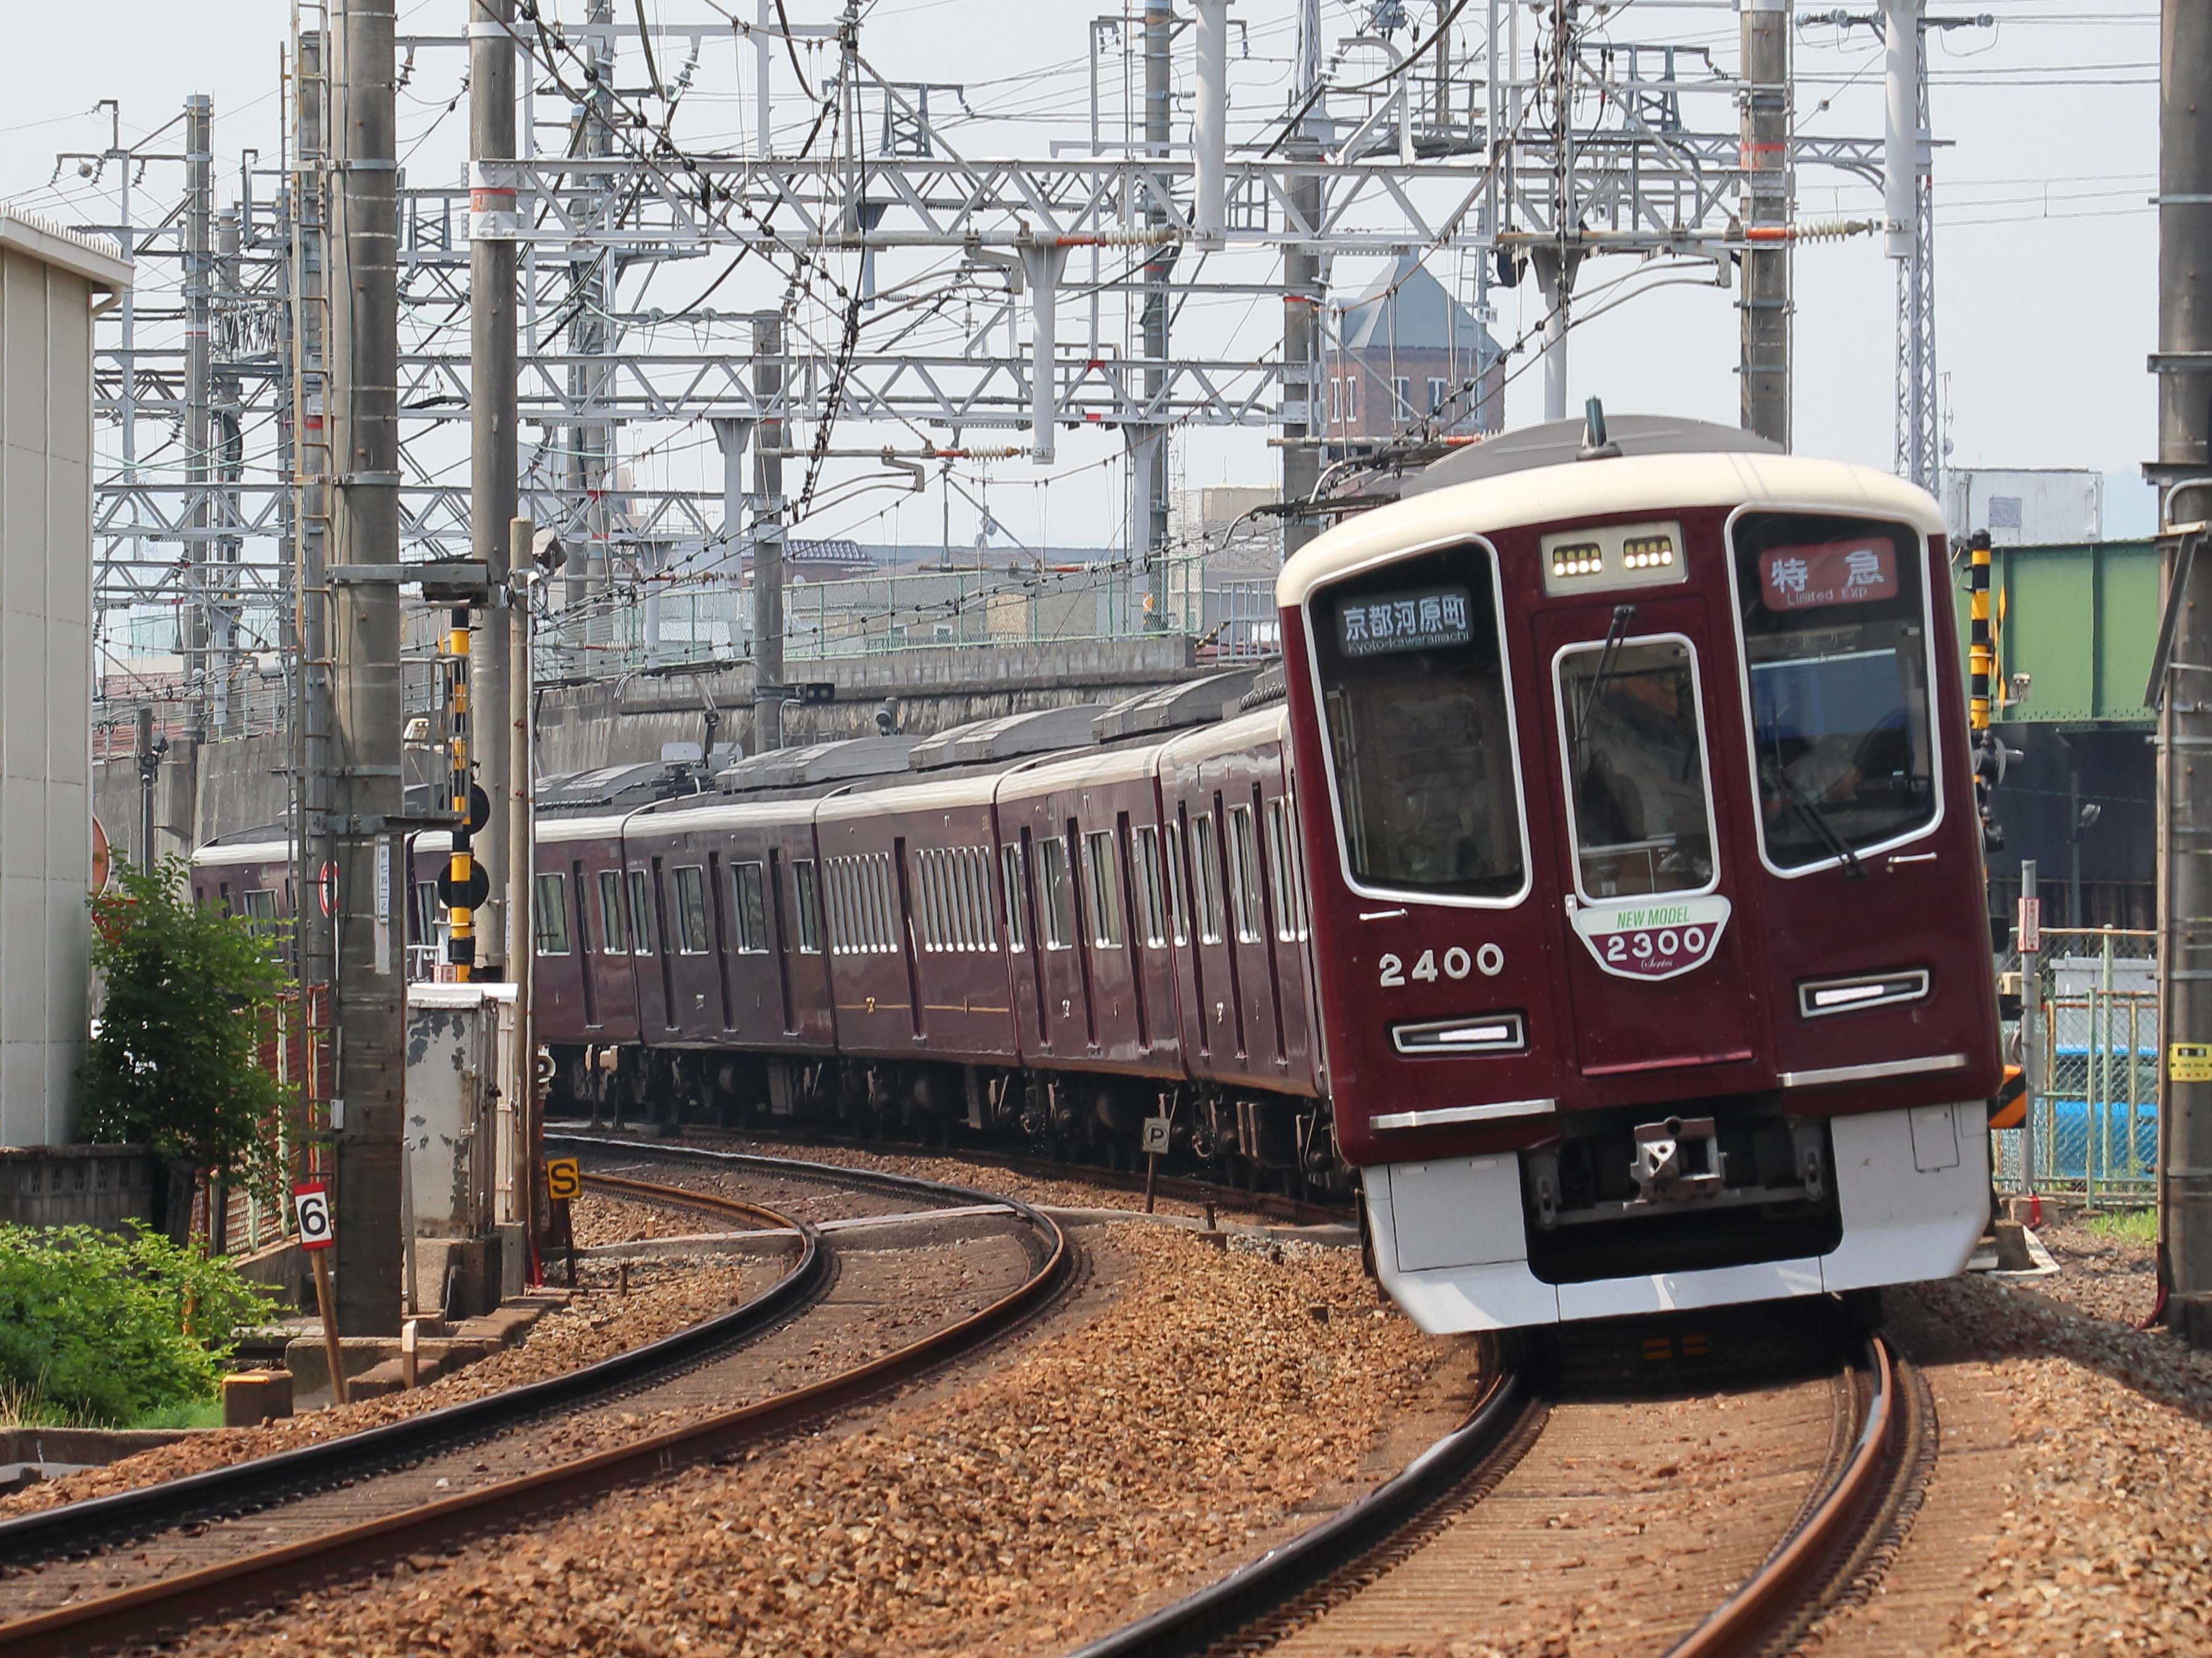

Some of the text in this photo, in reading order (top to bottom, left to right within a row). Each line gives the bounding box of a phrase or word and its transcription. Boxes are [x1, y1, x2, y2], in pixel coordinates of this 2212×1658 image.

[1787, 589, 1833, 606] Limited
[1343, 594, 1467, 641] 京都河原町
[1617, 905, 1689, 929] NEW MODEL
[1607, 927, 1705, 961] 2300
[1379, 942, 1504, 987] 2400
[1150, 1127, 1164, 1143] P
[551, 1163, 576, 1194] S
[300, 1199, 326, 1235] 6
